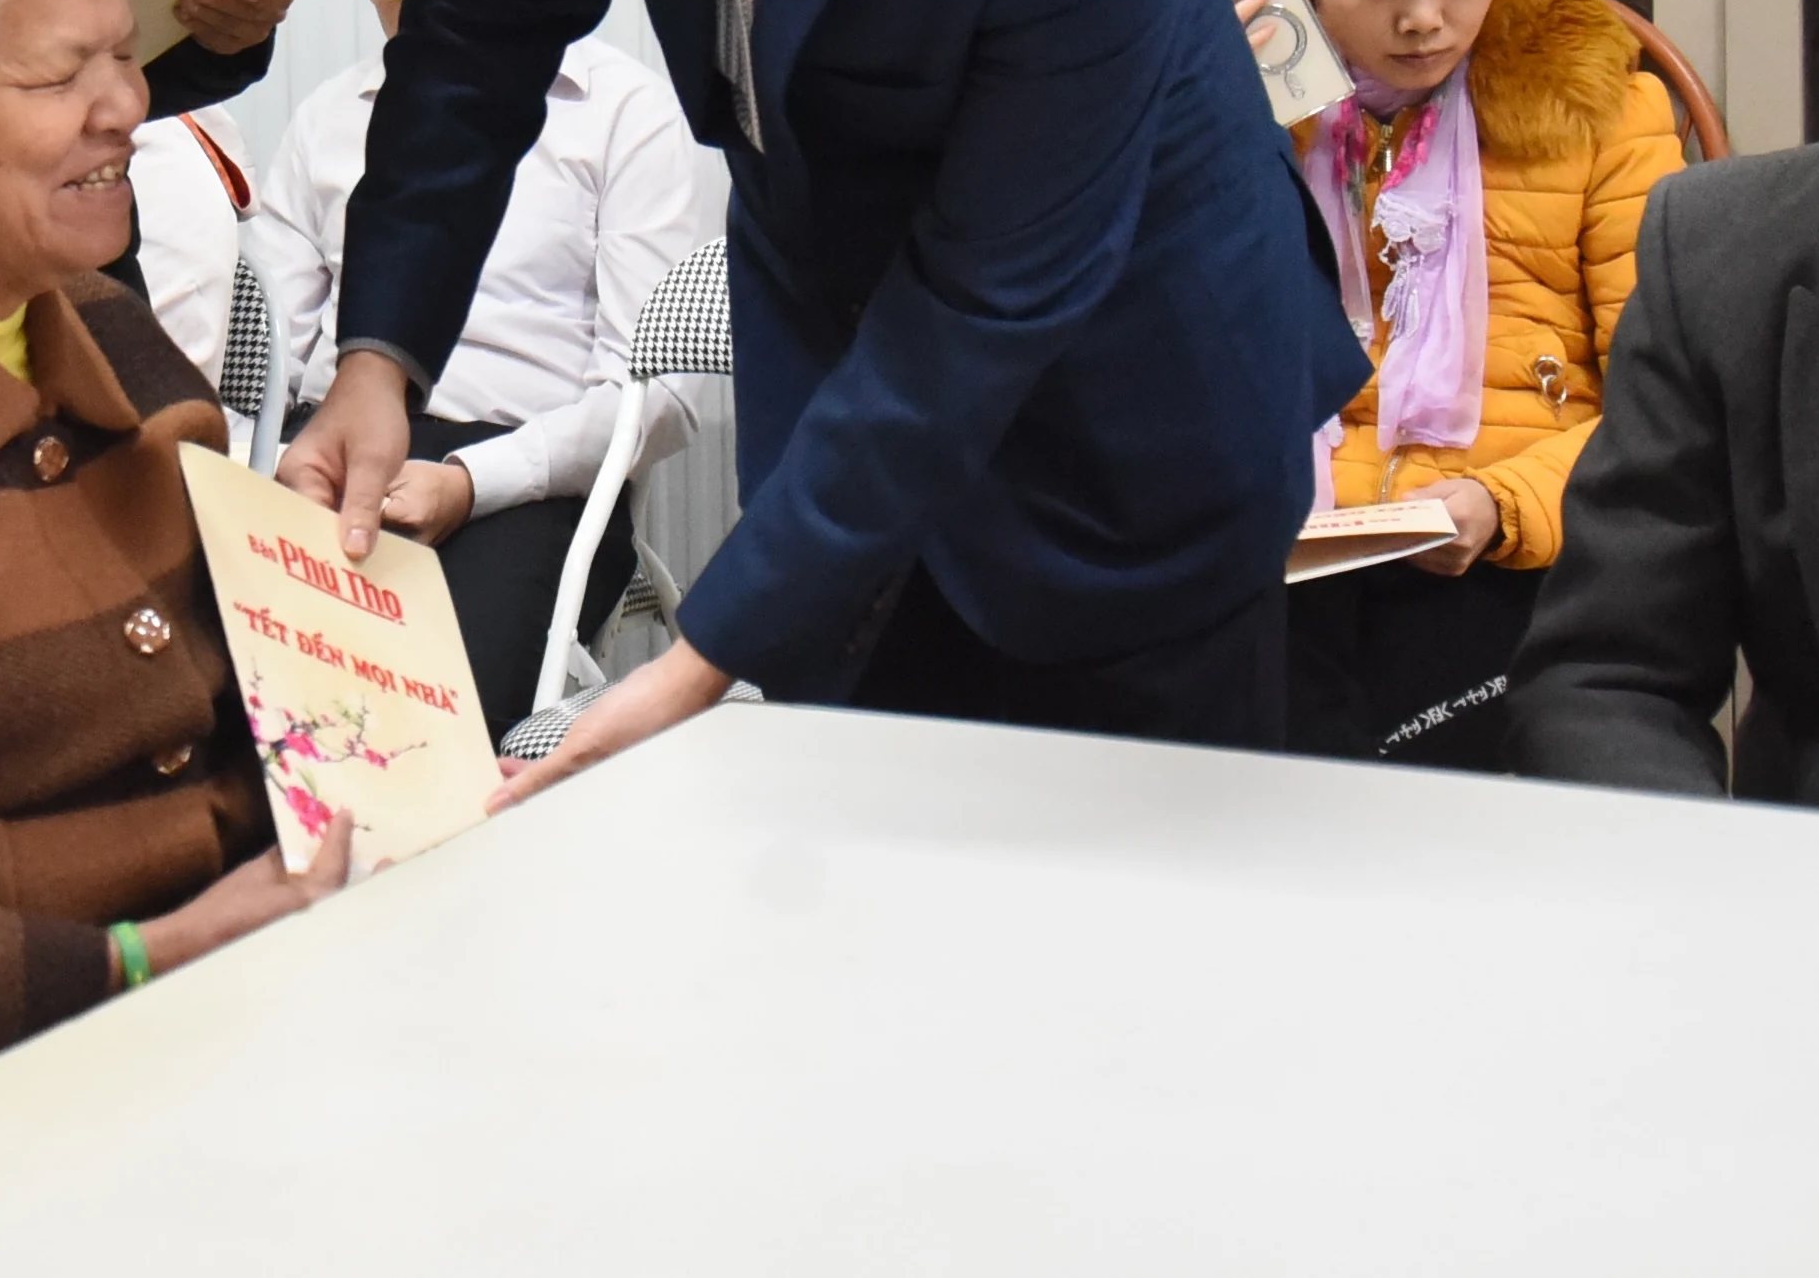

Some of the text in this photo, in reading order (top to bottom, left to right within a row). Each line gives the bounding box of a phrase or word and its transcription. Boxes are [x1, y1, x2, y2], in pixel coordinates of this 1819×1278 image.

[276, 535, 341, 595] Phú
[340, 567, 408, 626] Thọ
[294, 629, 347, 671] ĐẾN
[350, 654, 398, 694] MỌI
